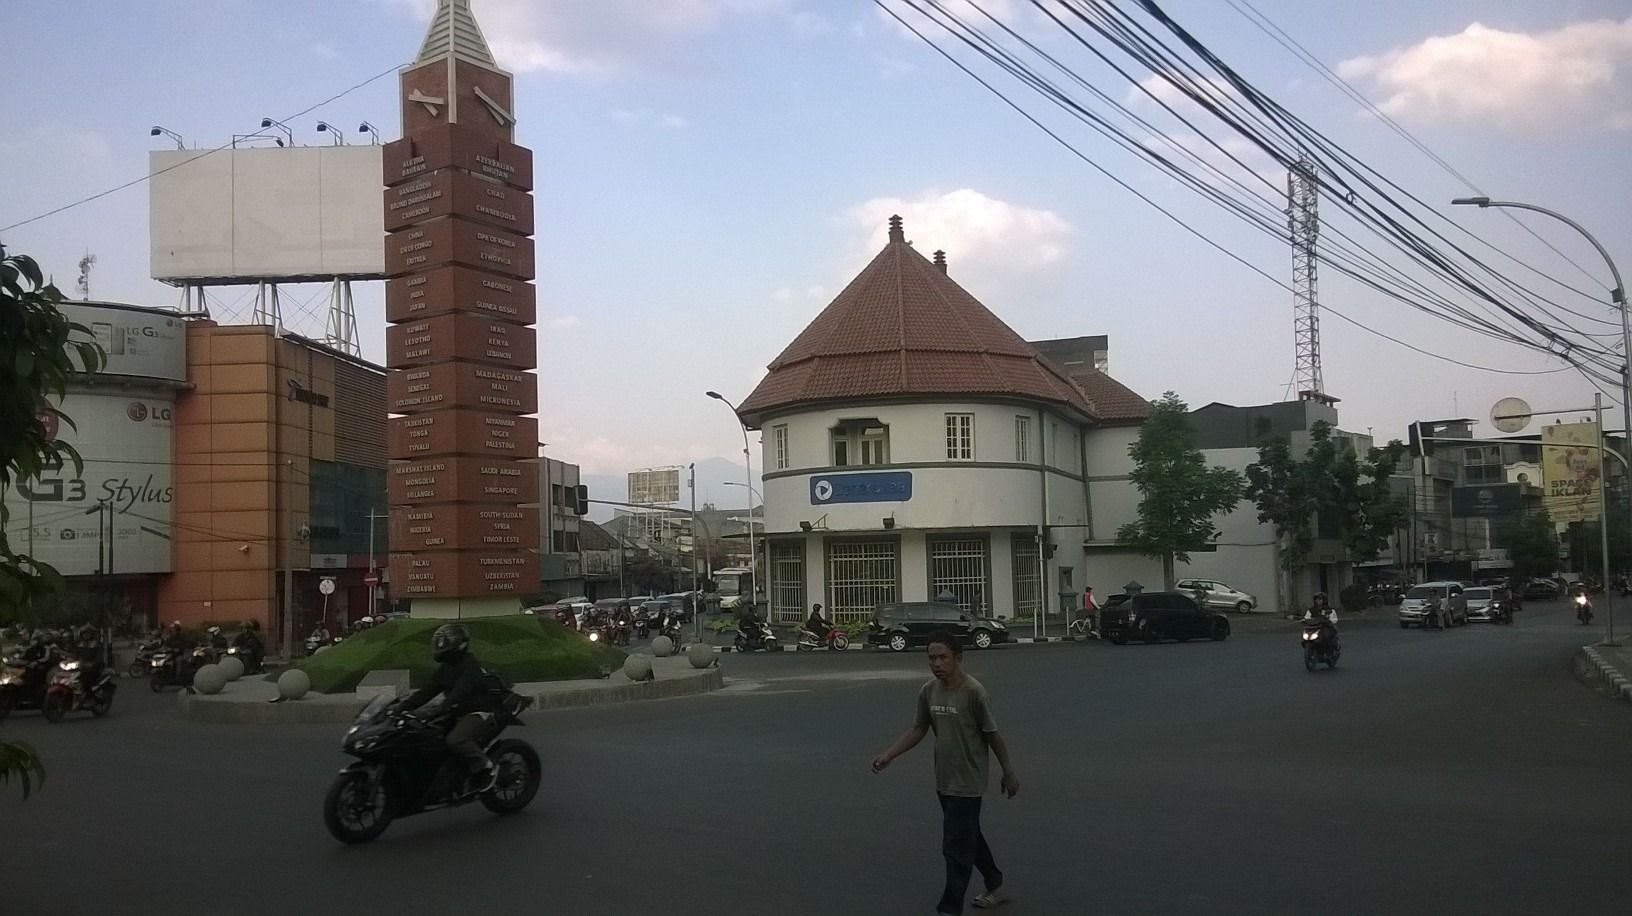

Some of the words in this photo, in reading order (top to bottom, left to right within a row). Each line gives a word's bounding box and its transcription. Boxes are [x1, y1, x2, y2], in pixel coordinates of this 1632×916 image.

[476, 154, 514, 172] AZERBAIJAN
[482, 165, 508, 178] BHUTAN
[486, 188, 504, 199] CHAD
[402, 206, 430, 219] CAMEROON
[476, 204, 516, 220] CHAMBODIA
[408, 230, 424, 240] CHINA
[414, 240, 432, 251] CONGO
[498, 238, 515, 247] KOREA
[476, 300, 497, 311] GUINEA
[498, 305, 518, 315] BISSAU
[126, 327, 139, 336] LG
[142, 326, 158, 338] G3
[407, 324, 429, 334] KUWAIT
[490, 325, 506, 334] IRAQ
[405, 336, 430, 346] LESOTHO
[488, 338, 509, 347] KENYA
[406, 349, 430, 358] MALAWI
[486, 350, 512, 359] LEBANON
[407, 372, 430, 380] RWANDA
[476, 370, 522, 382] MADAGASKAR
[408, 384, 430, 392] SENEGAL
[492, 383, 508, 391] MALI
[396, 398, 421, 406] SOLOMON
[422, 394, 443, 403] ISLAND
[480, 395, 520, 406] MICRONESIA
[152, 407, 171, 420] LG
[486, 418, 515, 427] MYANMAR
[423, 464, 445, 472] ISLAND
[481, 466, 498, 474] SAUDI
[500, 467, 521, 475] ARABIA
[406, 478, 435, 486] MONGOLIA
[1551, 479, 1591, 488] SPACE
[97, 474, 172, 514] Stylus
[484, 486, 518, 494] SINGAPORE
[1551, 488, 1591, 497] IKLAN
[408, 512, 433, 520] NAMIBIA
[485, 572, 520, 580] UZBEKISTAN
